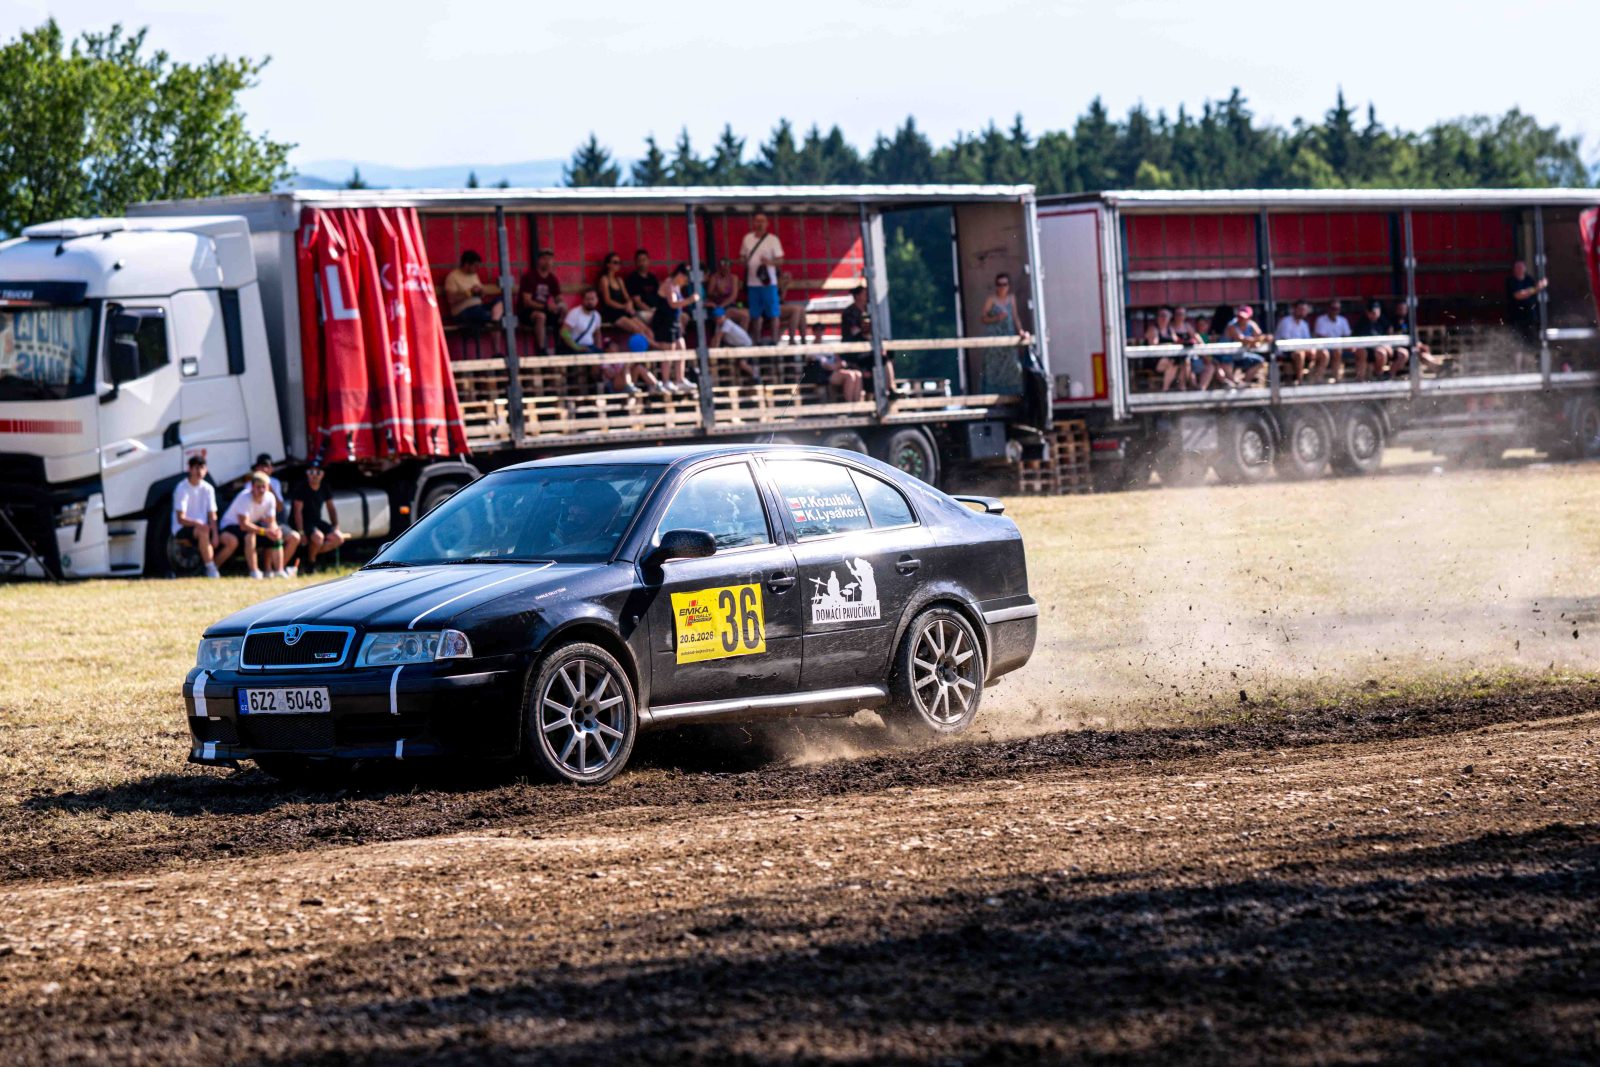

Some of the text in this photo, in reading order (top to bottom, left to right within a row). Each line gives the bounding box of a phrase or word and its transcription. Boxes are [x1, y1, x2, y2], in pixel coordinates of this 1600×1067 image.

[679, 606, 709, 616] EMKA
[719, 587, 760, 652] 36
[250, 690, 323, 711] 6Z2 5048
